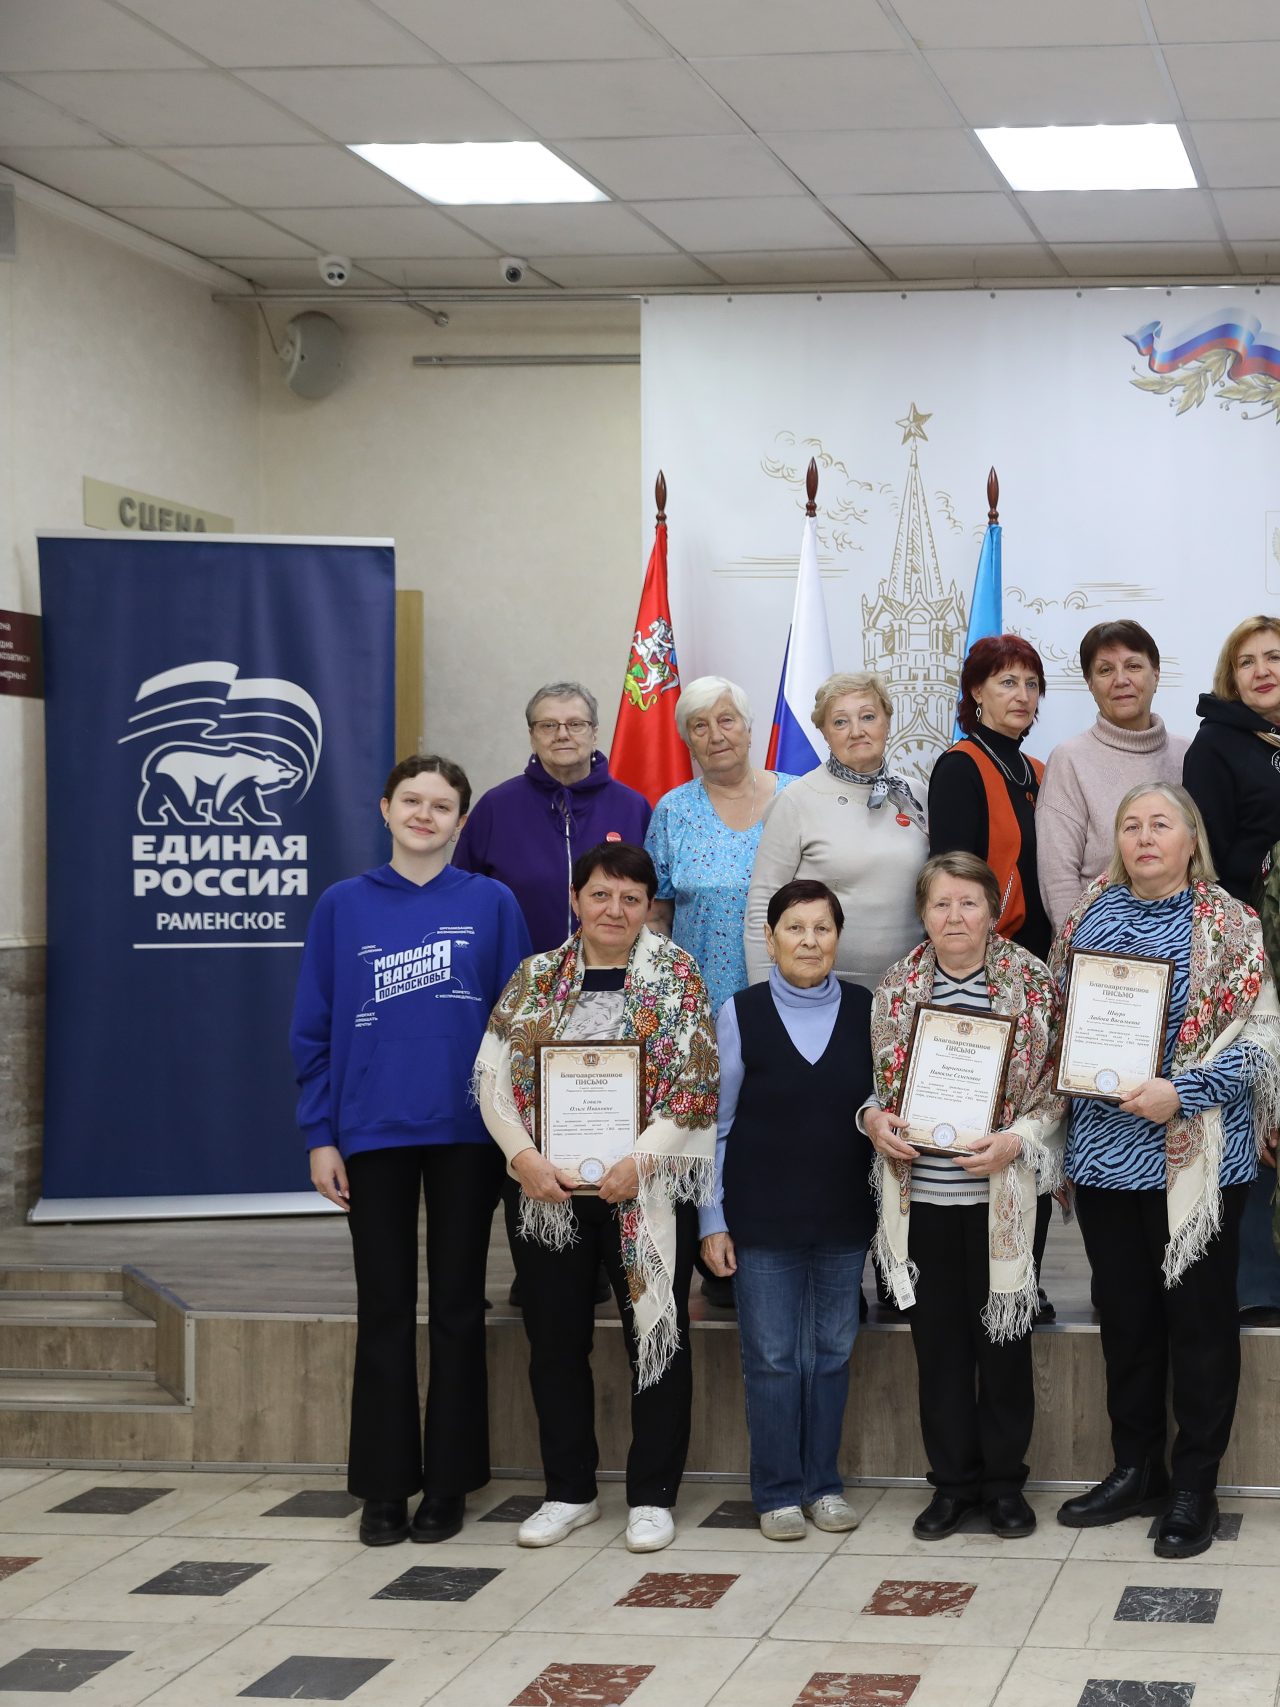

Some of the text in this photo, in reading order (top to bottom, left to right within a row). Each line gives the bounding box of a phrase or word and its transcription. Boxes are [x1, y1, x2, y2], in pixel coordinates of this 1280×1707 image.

[132, 835, 308, 865] ЕДИНАЯ
[134, 869, 309, 897] РОССИЯ
[157, 912, 286, 931] РАМЕНСКОЕ
[374, 939, 451, 973] МОЛОДАЯ
[379, 969, 447, 1000] ПОДМОСКОВЬЕ
[1102, 989, 1134, 999] ПИСЬМО
[945, 1044, 976, 1055] ПИСЬМО
